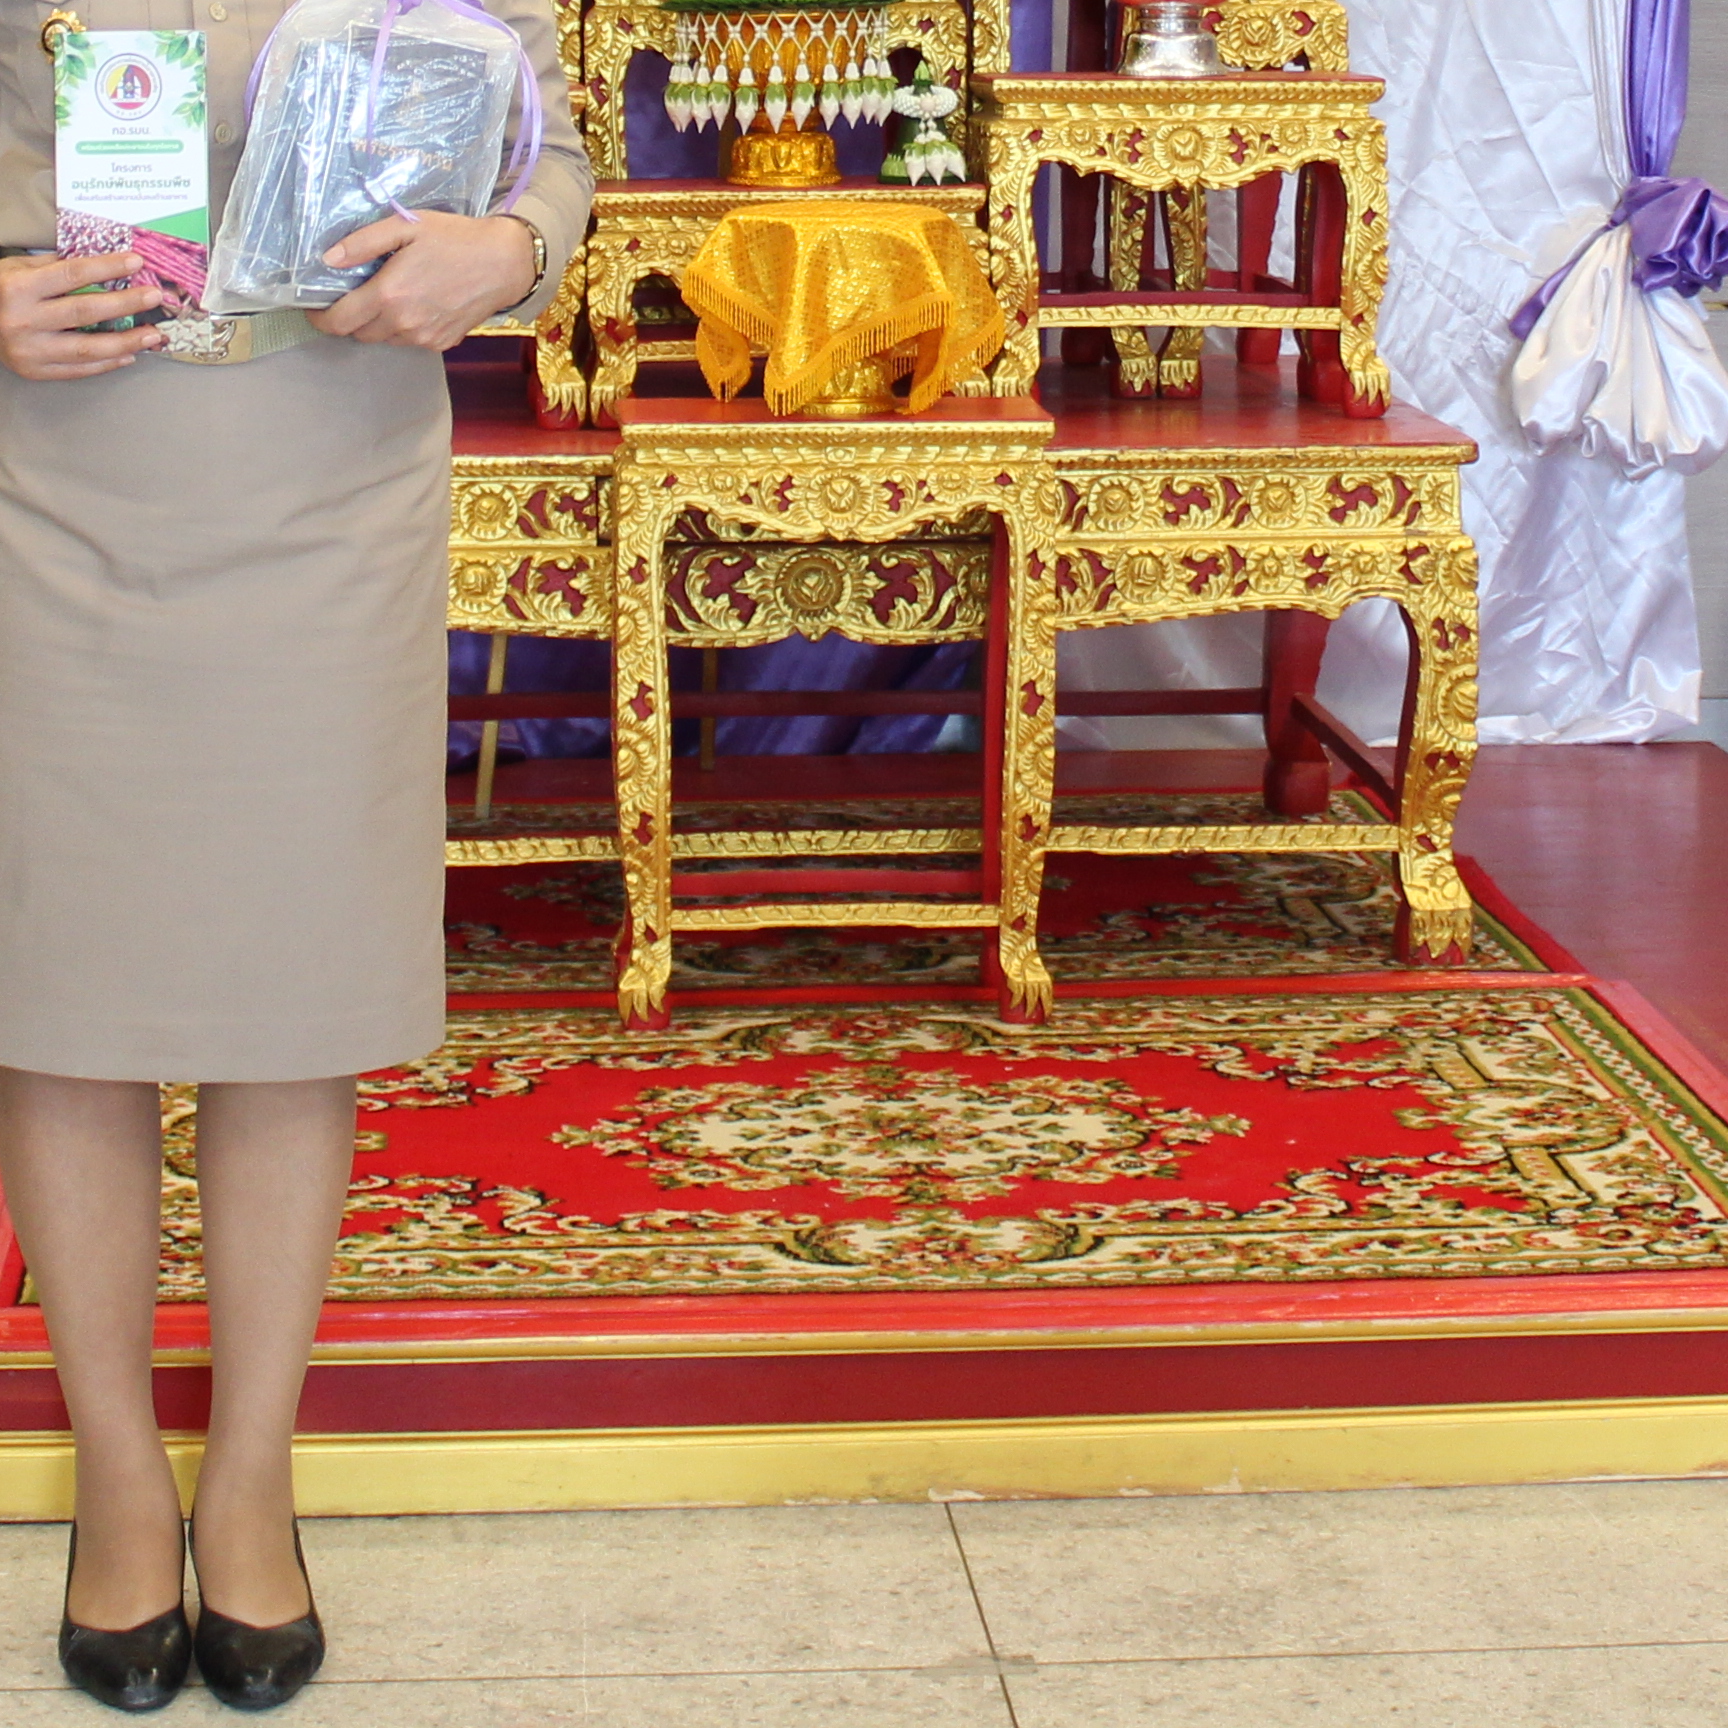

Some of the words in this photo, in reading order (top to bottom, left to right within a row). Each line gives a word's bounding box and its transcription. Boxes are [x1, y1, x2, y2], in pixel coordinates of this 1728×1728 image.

[110, 162, 153, 173] โครงการ
[71, 176, 191, 193] อนุรักษ์พันธุกรรมพืช
